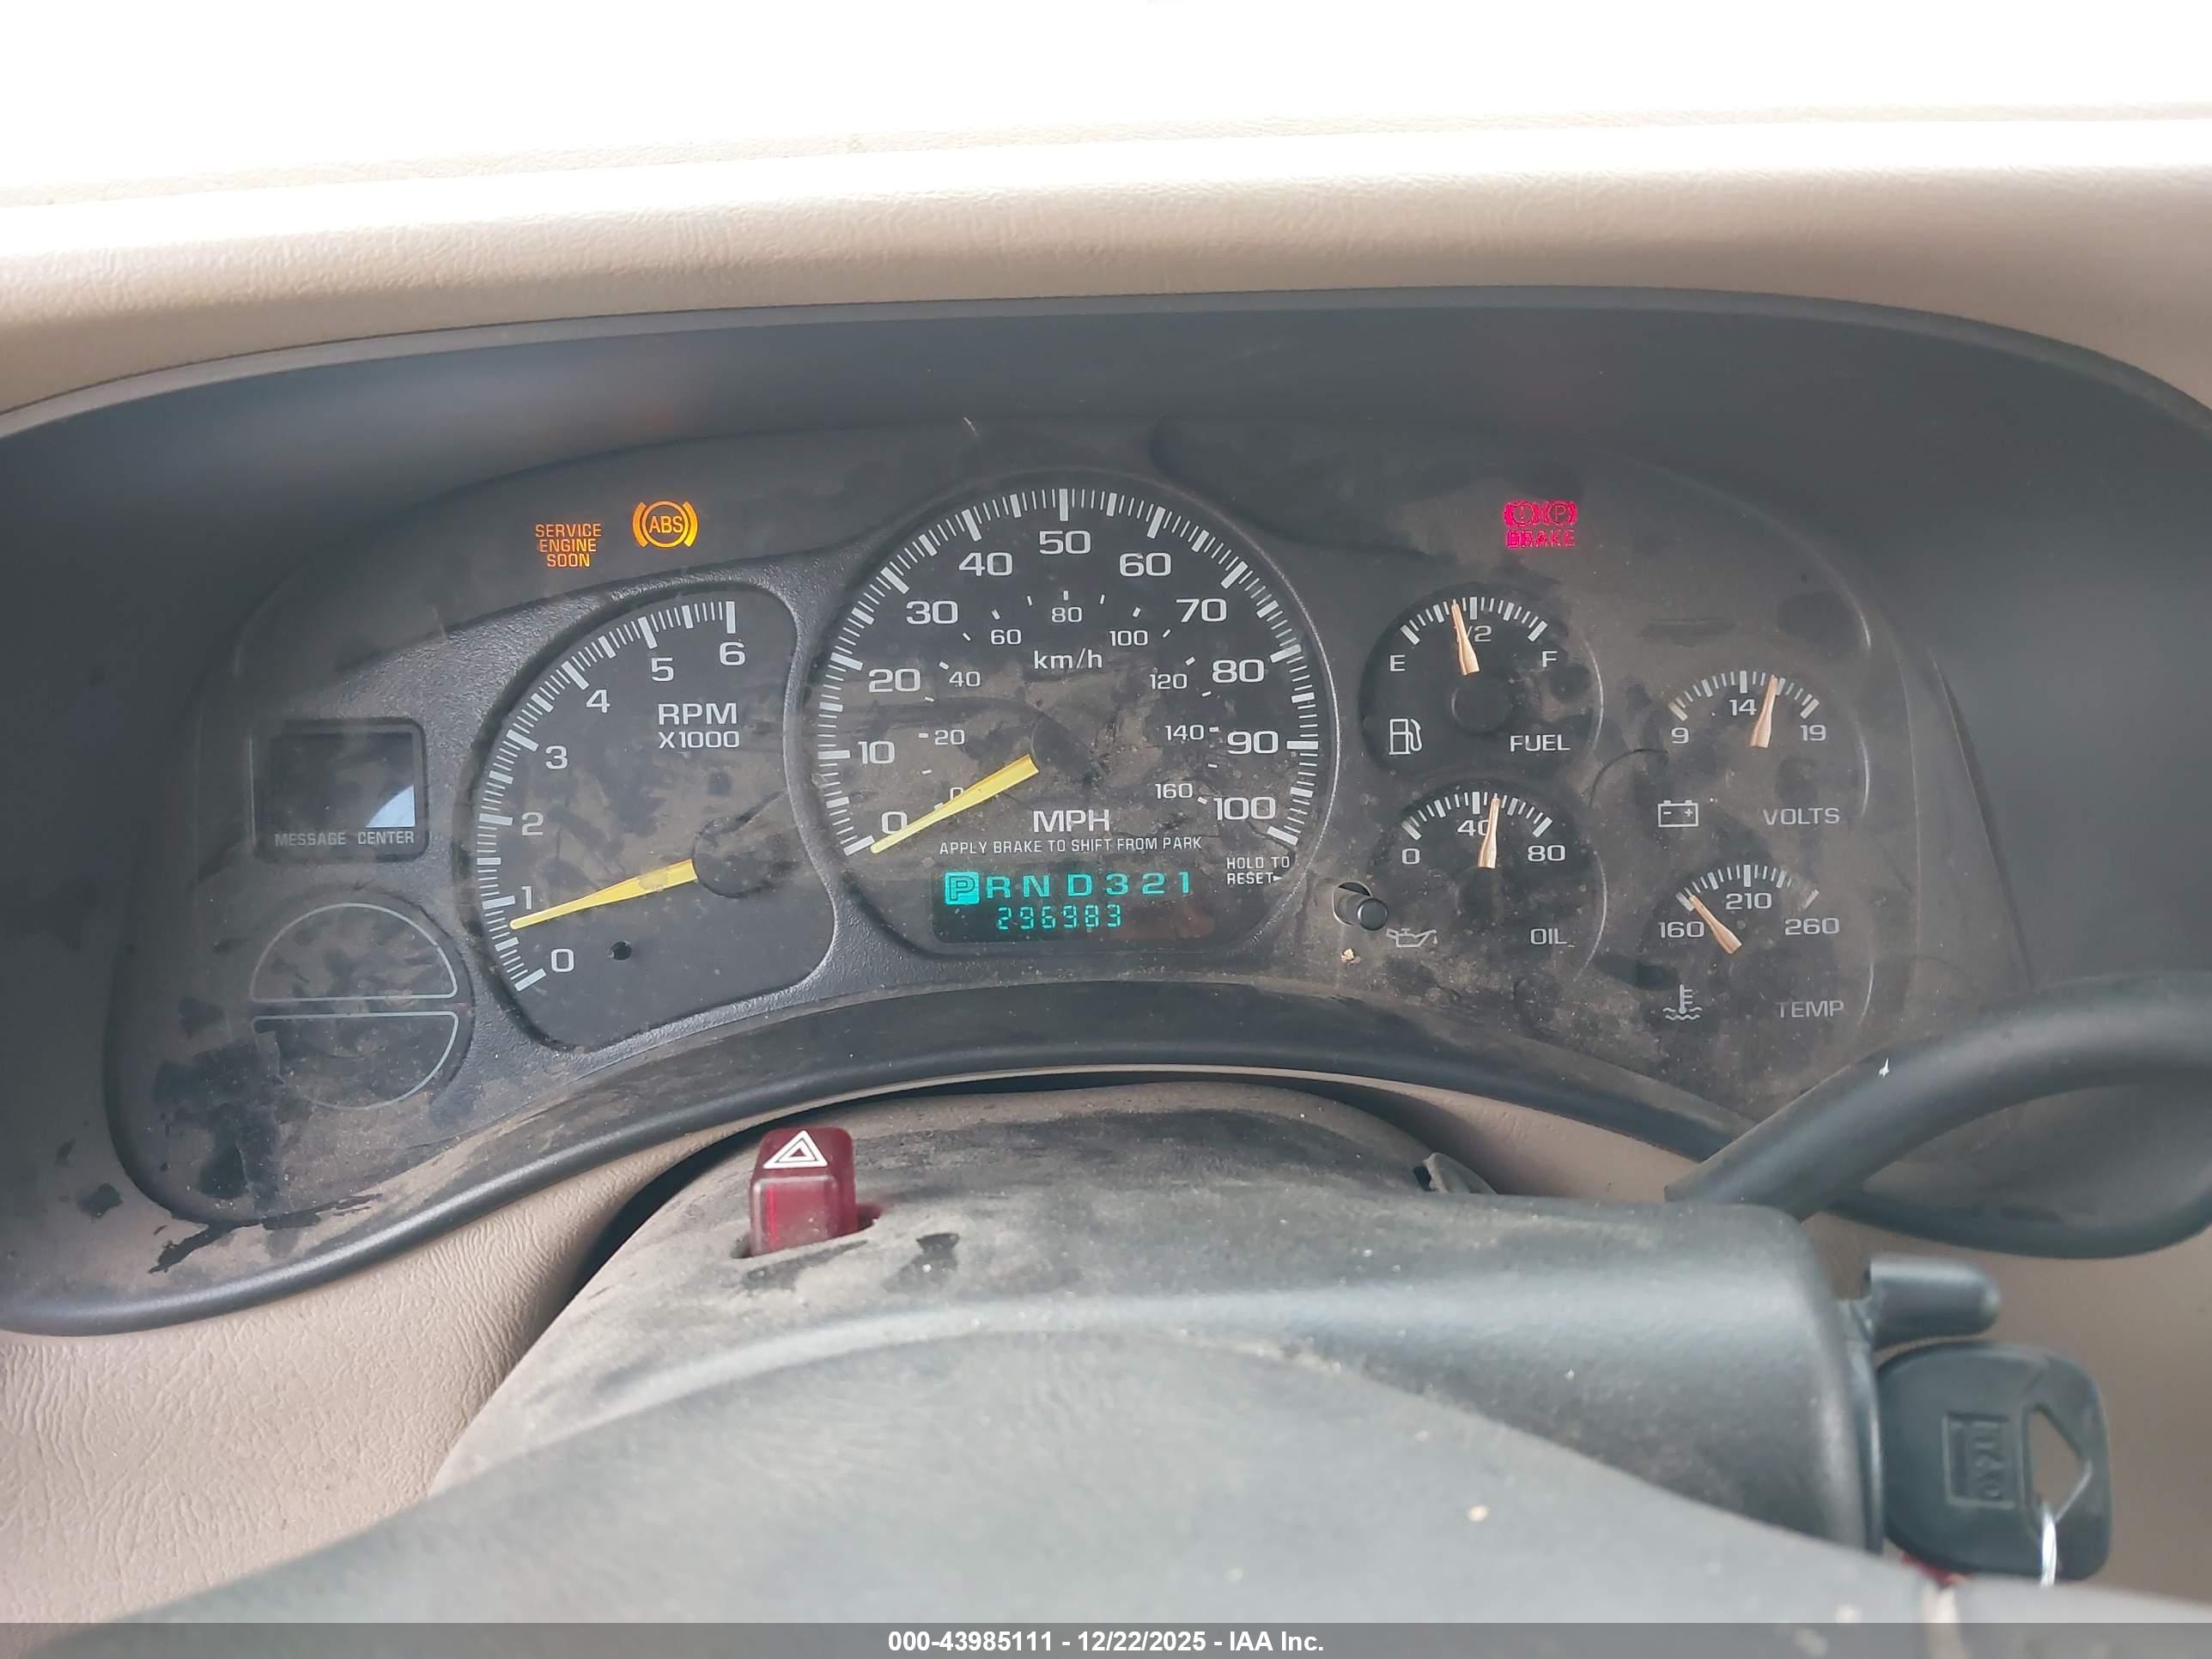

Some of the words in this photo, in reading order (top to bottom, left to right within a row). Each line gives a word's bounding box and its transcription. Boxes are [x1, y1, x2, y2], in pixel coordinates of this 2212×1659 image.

[536, 523, 602, 538] SERVICE
[649, 515, 684, 534] ABS
[539, 538, 597, 552] ENGINE
[1039, 531, 1091, 555] 50
[546, 553, 590, 568] SOON
[958, 552, 1013, 576] 40
[1119, 552, 1172, 577] 60
[906, 600, 958, 624] 30
[1051, 606, 1083, 623] 80
[1176, 598, 1227, 623] 70
[990, 629, 1022, 645] 60
[1109, 629, 1149, 647] 100
[720, 643, 745, 666] 6
[1034, 647, 1103, 670] km/h
[1389, 654, 1406, 672] E
[1541, 651, 1559, 668] F
[651, 658, 674, 682] 5
[1212, 659, 1265, 684] 80
[868, 668, 921, 693] 20
[949, 672, 981, 688] 40
[1149, 673, 1188, 690] 120
[586, 690, 611, 713] 4
[1729, 699, 1757, 716] 14
[658, 702, 738, 726] RPM
[658, 731, 740, 750] X1000
[934, 730, 965, 745] 20
[1164, 725, 1204, 740] 140
[1671, 728, 1689, 744] 9
[1800, 724, 1826, 742] 19
[1227, 731, 1279, 755] 90
[1509, 734, 1571, 752] FUEL
[544, 745, 568, 770] 3
[858, 741, 895, 764] 10
[1155, 783, 1193, 799] 160
[1213, 797, 1276, 821] 100
[1762, 807, 1840, 825] VOLTS
[521, 812, 544, 836] 2
[881, 811, 908, 835] 0
[1033, 809, 1109, 833] MPH
[1456, 819, 1490, 837] 40
[274, 832, 346, 847] MESSAGE
[357, 830, 415, 845] CENTER
[939, 840, 988, 855] APPLY
[993, 839, 1042, 854] BRAKE
[1048, 839, 1066, 853] TO
[1071, 837, 1112, 853] SHIFT
[1117, 836, 1158, 852] FROM
[1163, 836, 1202, 850] PARK
[1401, 848, 1420, 865] 0
[1527, 844, 1565, 862] 80
[1226, 856, 1265, 870] HOLD
[1270, 855, 1291, 869] TO
[949, 874, 976, 902] P
[987, 875, 1012, 899] R
[1023, 874, 1051, 898] N
[1066, 873, 1093, 897] D
[1105, 872, 1129, 896] 3
[1142, 872, 1166, 895] 2
[1177, 871, 1190, 894] 1
[1226, 872, 1274, 885] RESET
[520, 885, 533, 910] 1
[1725, 892, 1772, 910] 210
[996, 903, 1121, 930] 296983
[1658, 921, 1705, 939] 160
[1784, 917, 1840, 936] 260
[1530, 927, 1567, 945] OIL
[550, 948, 574, 973] 0
[1774, 1000, 1845, 1018] TEMP
